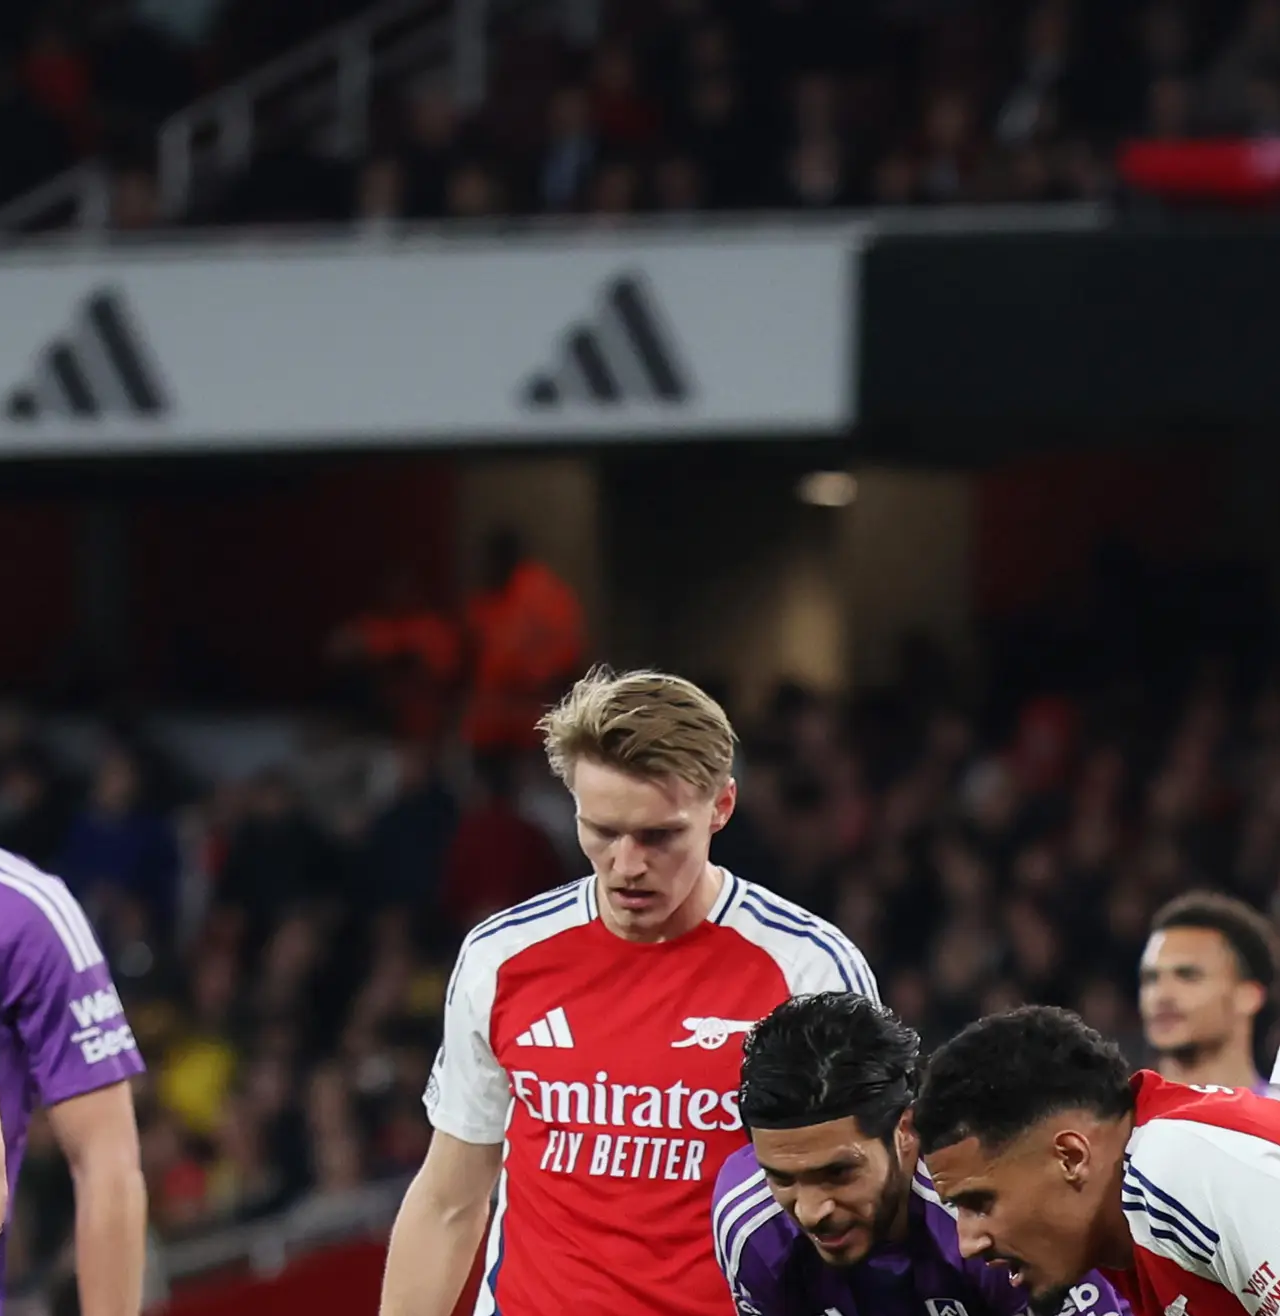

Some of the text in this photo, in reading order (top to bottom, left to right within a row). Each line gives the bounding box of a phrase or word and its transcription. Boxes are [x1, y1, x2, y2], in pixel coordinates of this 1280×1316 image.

[511, 1070, 744, 1132] Emirates
[540, 1129, 707, 1181] FLY BETTER
[1241, 1260, 1276, 1298] VISIT
